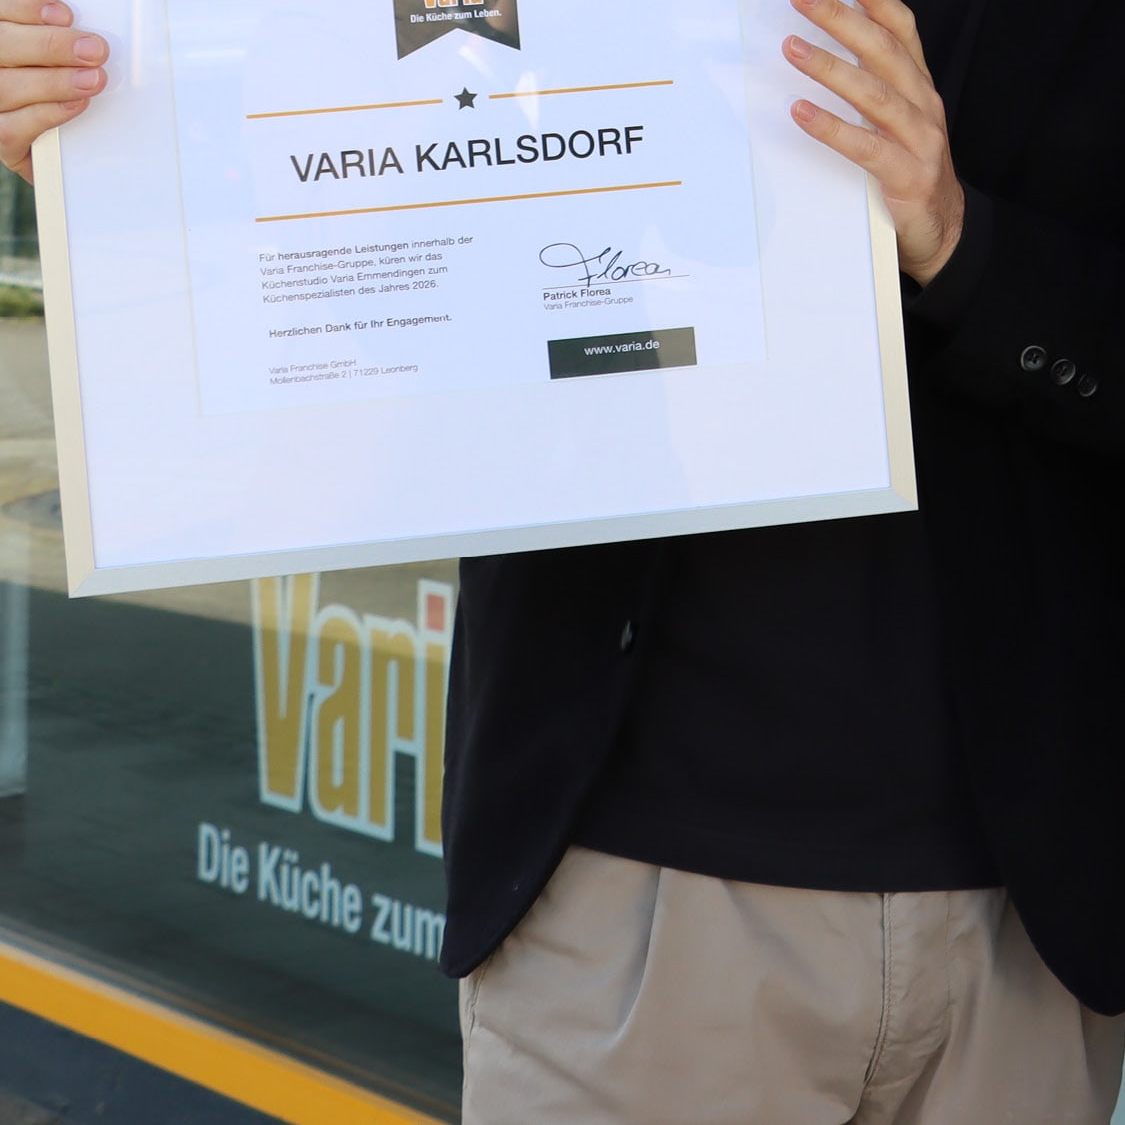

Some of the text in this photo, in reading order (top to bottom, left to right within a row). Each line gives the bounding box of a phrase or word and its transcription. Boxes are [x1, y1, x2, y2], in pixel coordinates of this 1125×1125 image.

[410, 8, 502, 23] Die Küche zum Leben.
[290, 126, 645, 182] VARIA KARLSDORF
[259, 236, 473, 262] Für herausragende Leistungen innerhalb der
[260, 252, 443, 276] Varia Franchise-Gruppe, küren wir das
[262, 266, 448, 290] Küchenstudio Varia Emmendingen zum
[263, 280, 438, 304] Küchenspezialisten des Jahres 2026.
[543, 288, 611, 300] Patrick Florea
[565, 296, 633, 308] Franchise-Gruppe
[269, 314, 452, 338] Herzlichen Dank für Ihr Engagement.
[584, 340, 660, 355] www.varia.de
[269, 358, 356, 374] Varia Franchise GmbH
[341, 371, 347, 379] 2
[354, 368, 379, 377] 71229
[381, 364, 418, 375] Leonberg
[197, 823, 446, 961] Die Küche zum
